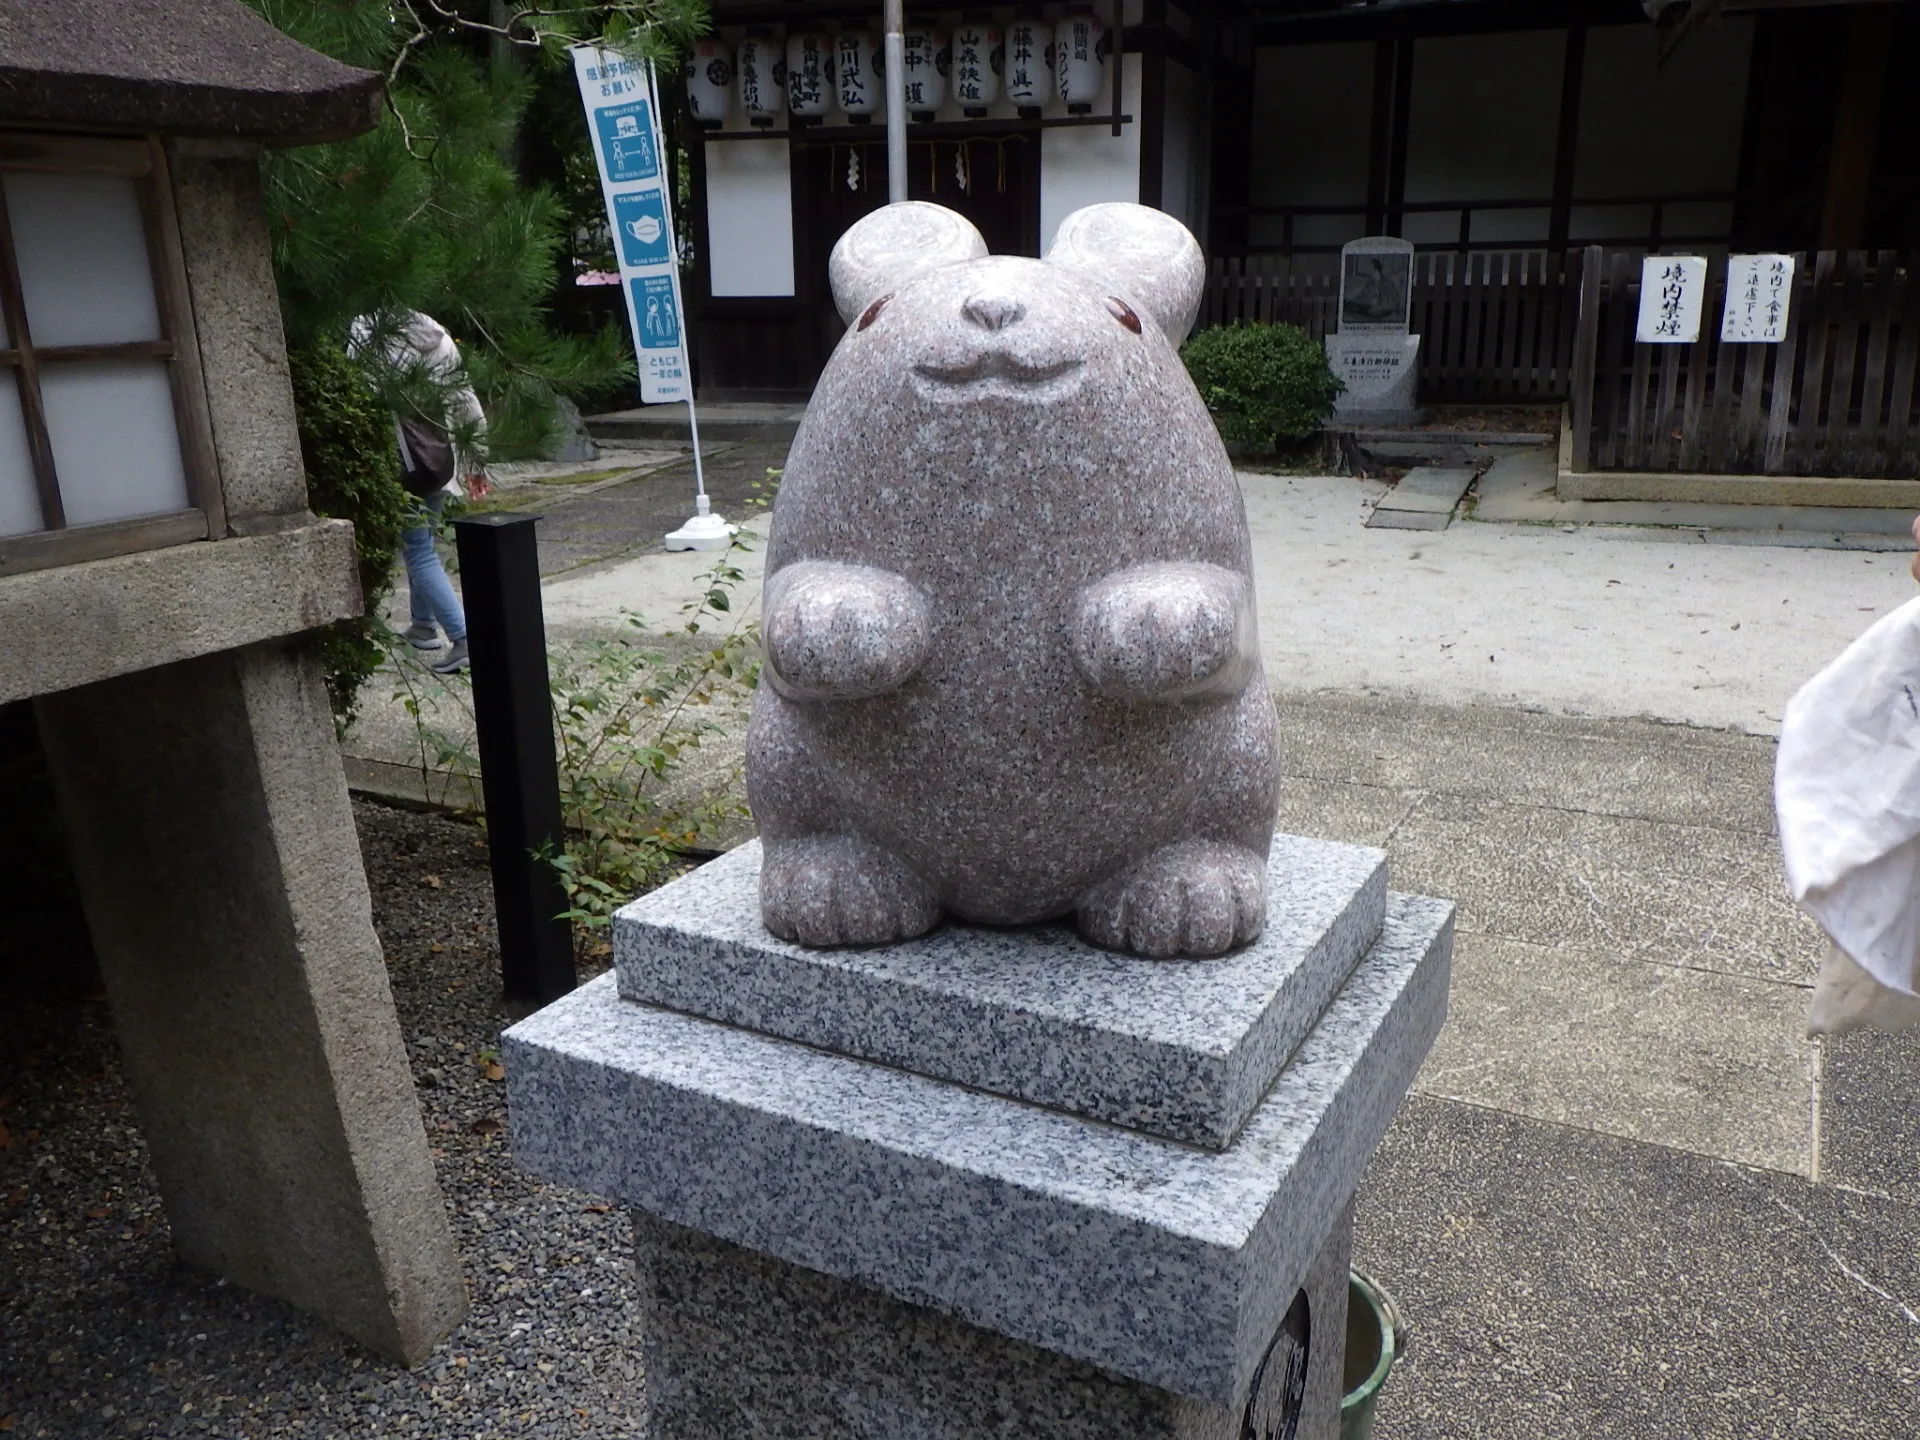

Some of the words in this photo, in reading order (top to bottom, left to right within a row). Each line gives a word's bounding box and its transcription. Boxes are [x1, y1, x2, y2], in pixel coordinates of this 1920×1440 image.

[600, 79, 636, 97] お願い
[1655, 263, 1687, 337] 境内禁煙
